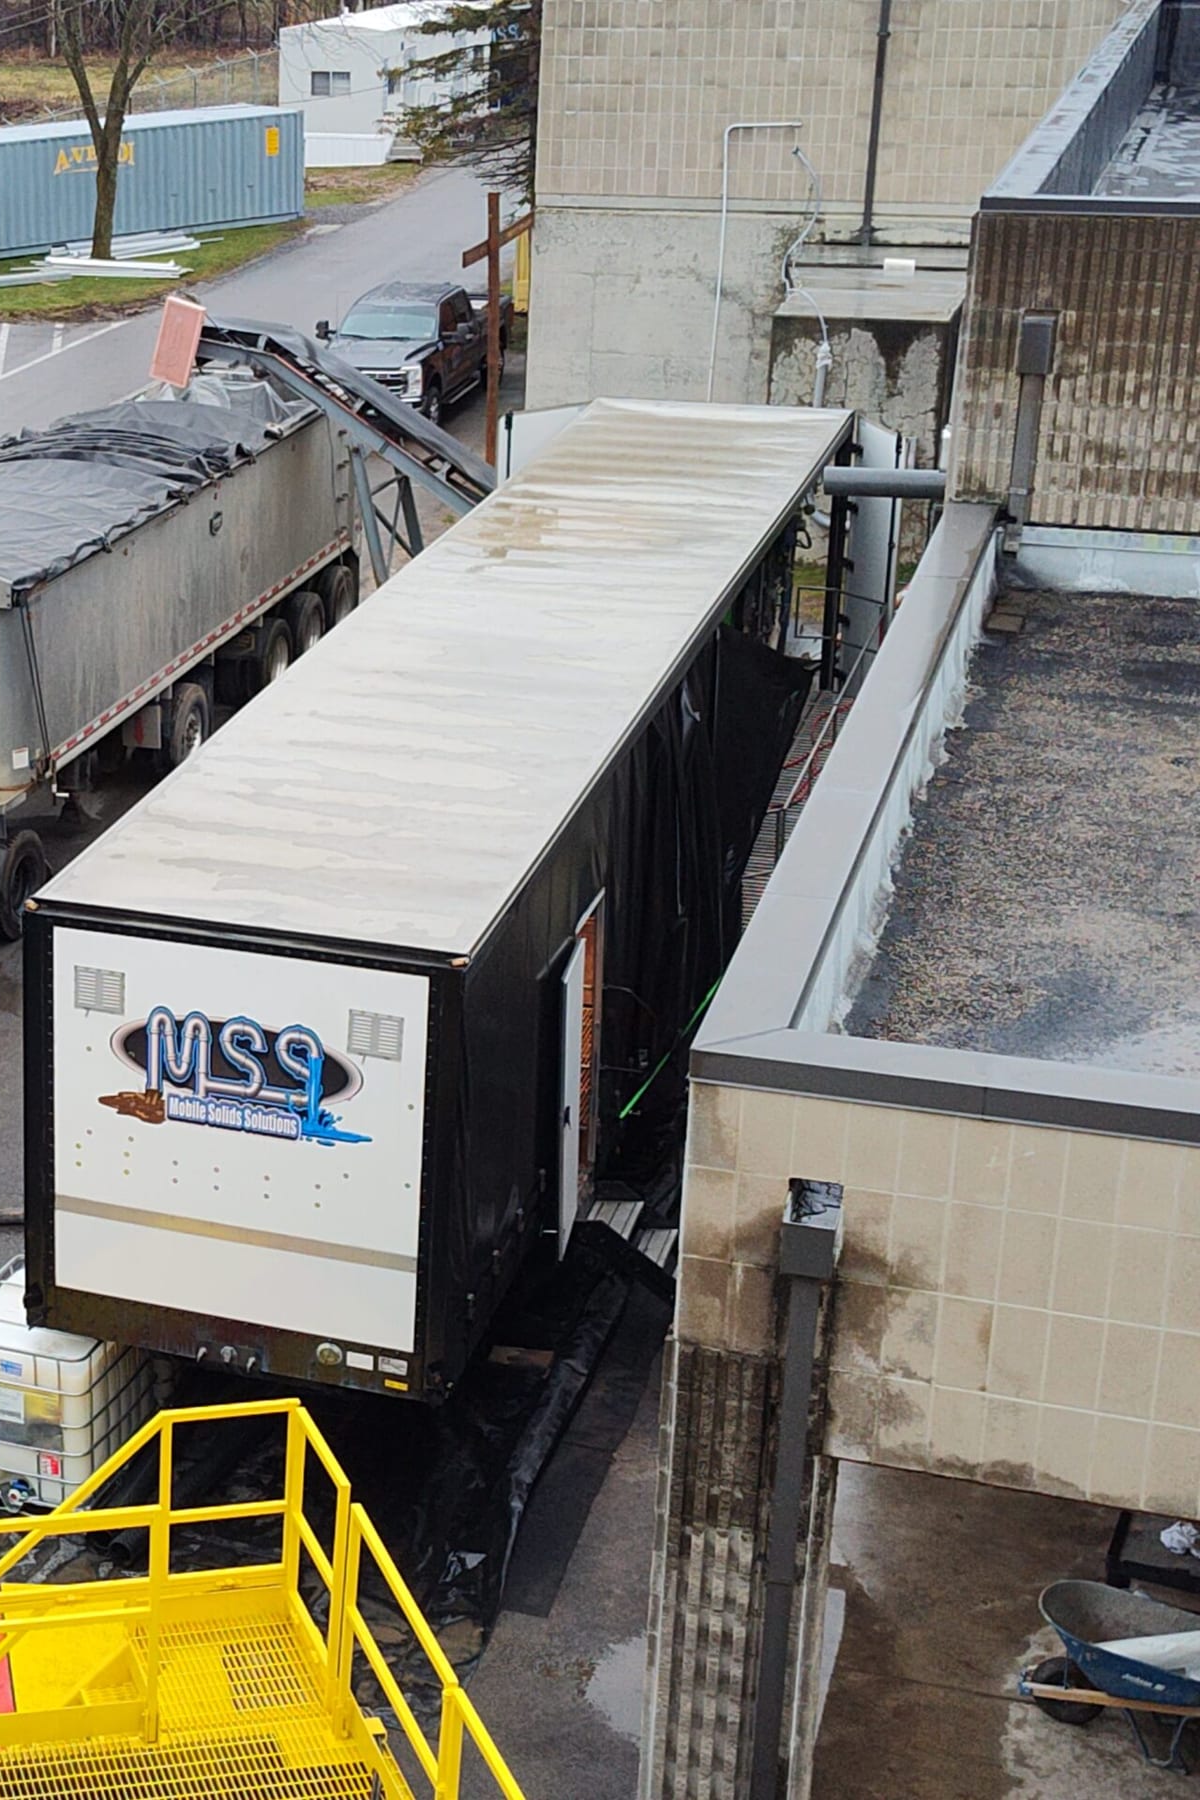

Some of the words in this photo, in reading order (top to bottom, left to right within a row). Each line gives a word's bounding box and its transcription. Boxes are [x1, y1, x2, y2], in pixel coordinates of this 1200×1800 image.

[146, 1006, 324, 1105] MSS
[169, 1096, 207, 1120] Mobile
[207, 1102, 242, 1126] Solids
[243, 1108, 298, 1135] Solutions
